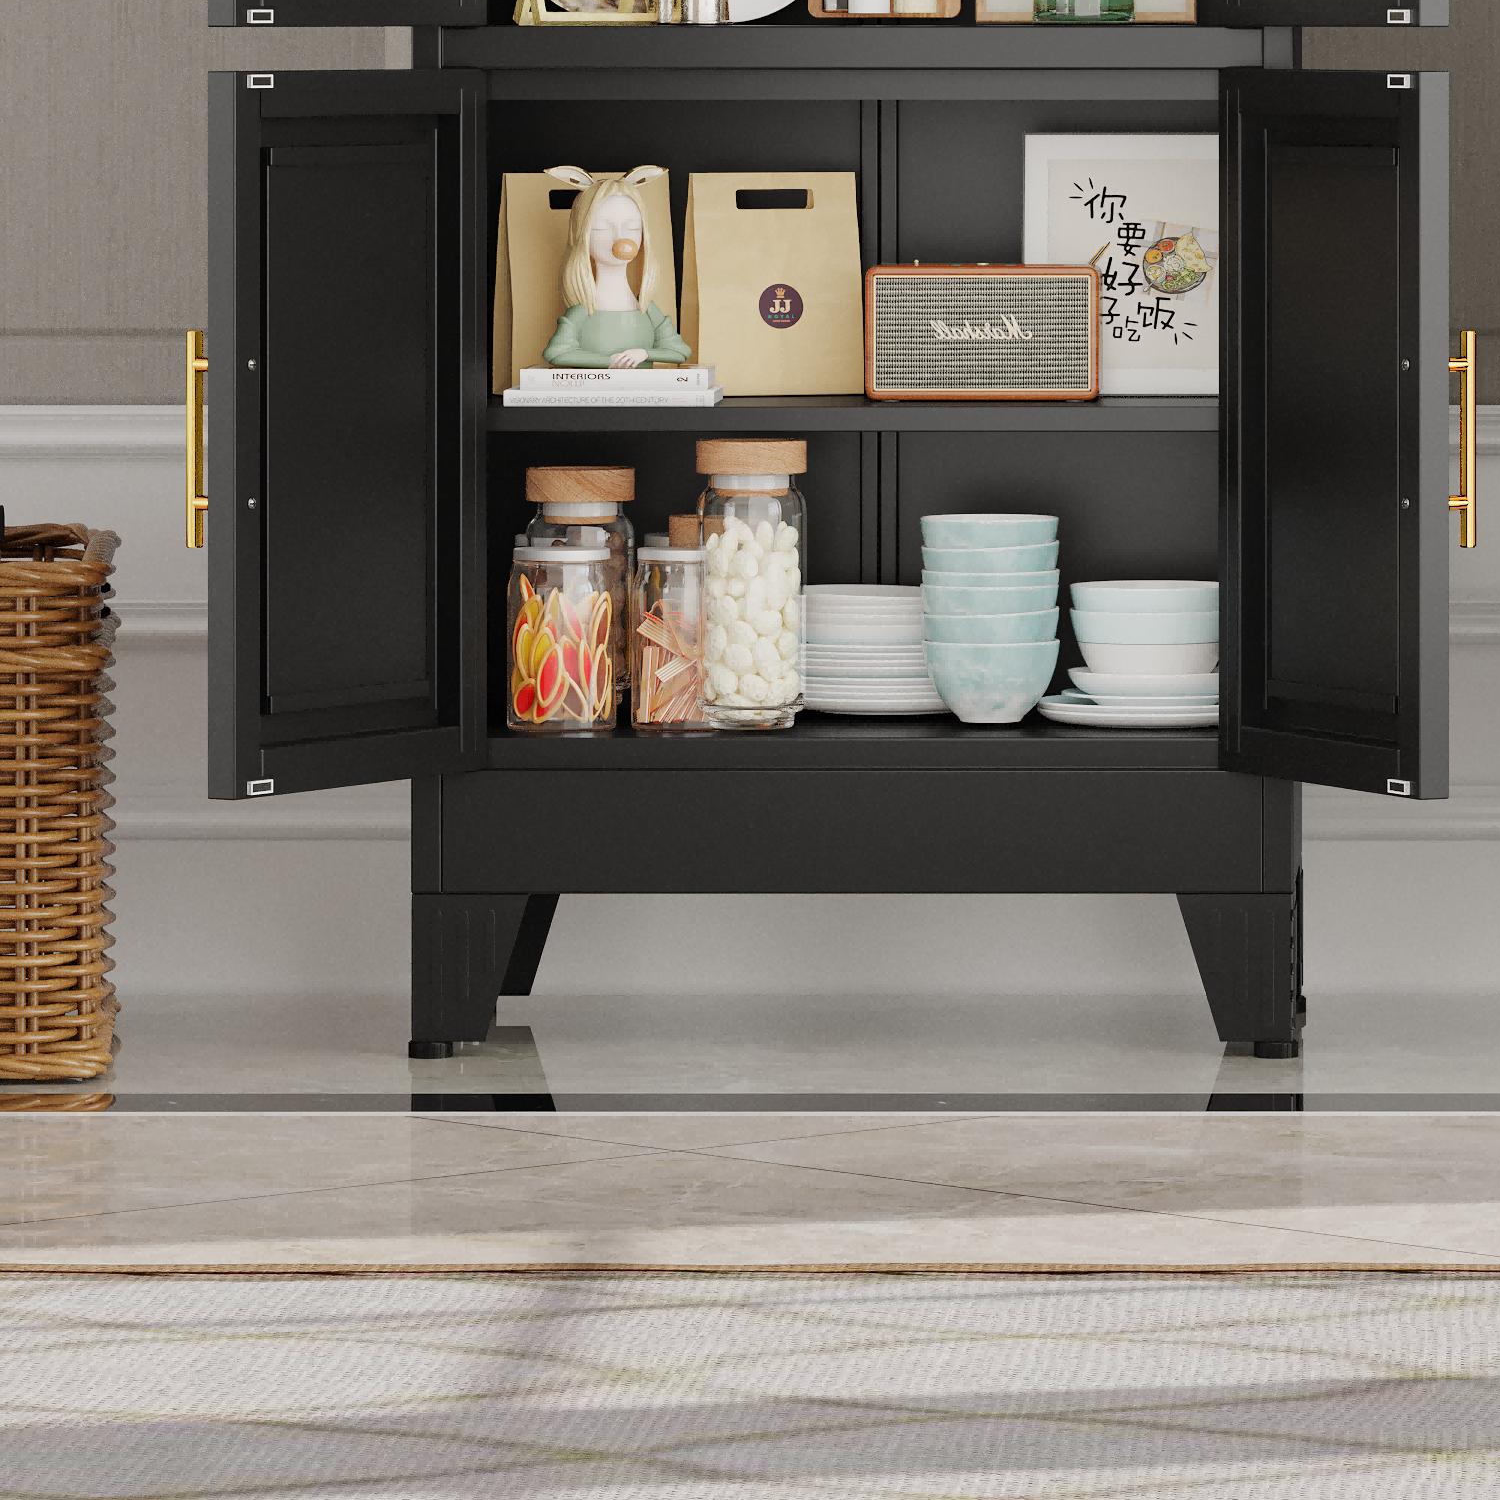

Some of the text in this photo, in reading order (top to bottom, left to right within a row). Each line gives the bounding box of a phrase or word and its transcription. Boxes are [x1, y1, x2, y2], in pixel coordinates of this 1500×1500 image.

[1084, 186, 1127, 224] 你
[1117, 222, 1146, 256] 要
[769, 299, 792, 314] JJ
[552, 373, 611, 381] INTERIORS
